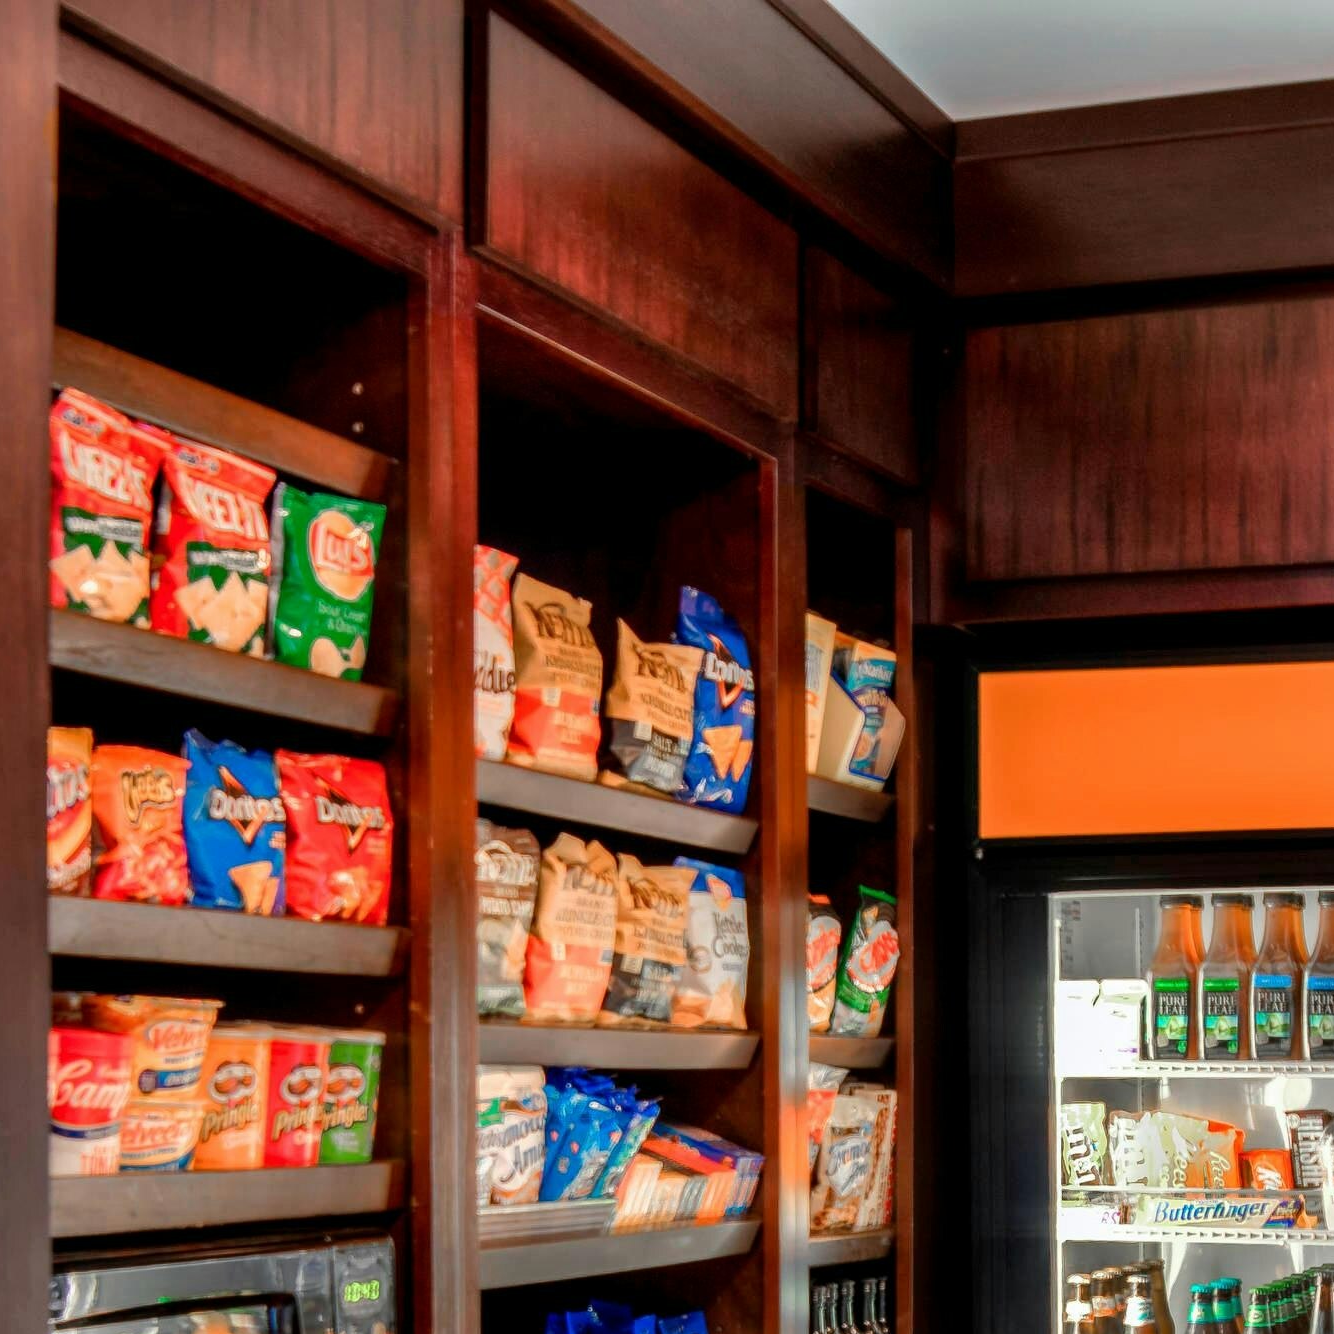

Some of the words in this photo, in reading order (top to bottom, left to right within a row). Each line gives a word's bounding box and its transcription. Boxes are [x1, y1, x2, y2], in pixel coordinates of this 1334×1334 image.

[210, 787, 286, 822] Doritos
[317, 796, 385, 830] Doritos
[1154, 1198, 1268, 1224] Butterfinger
